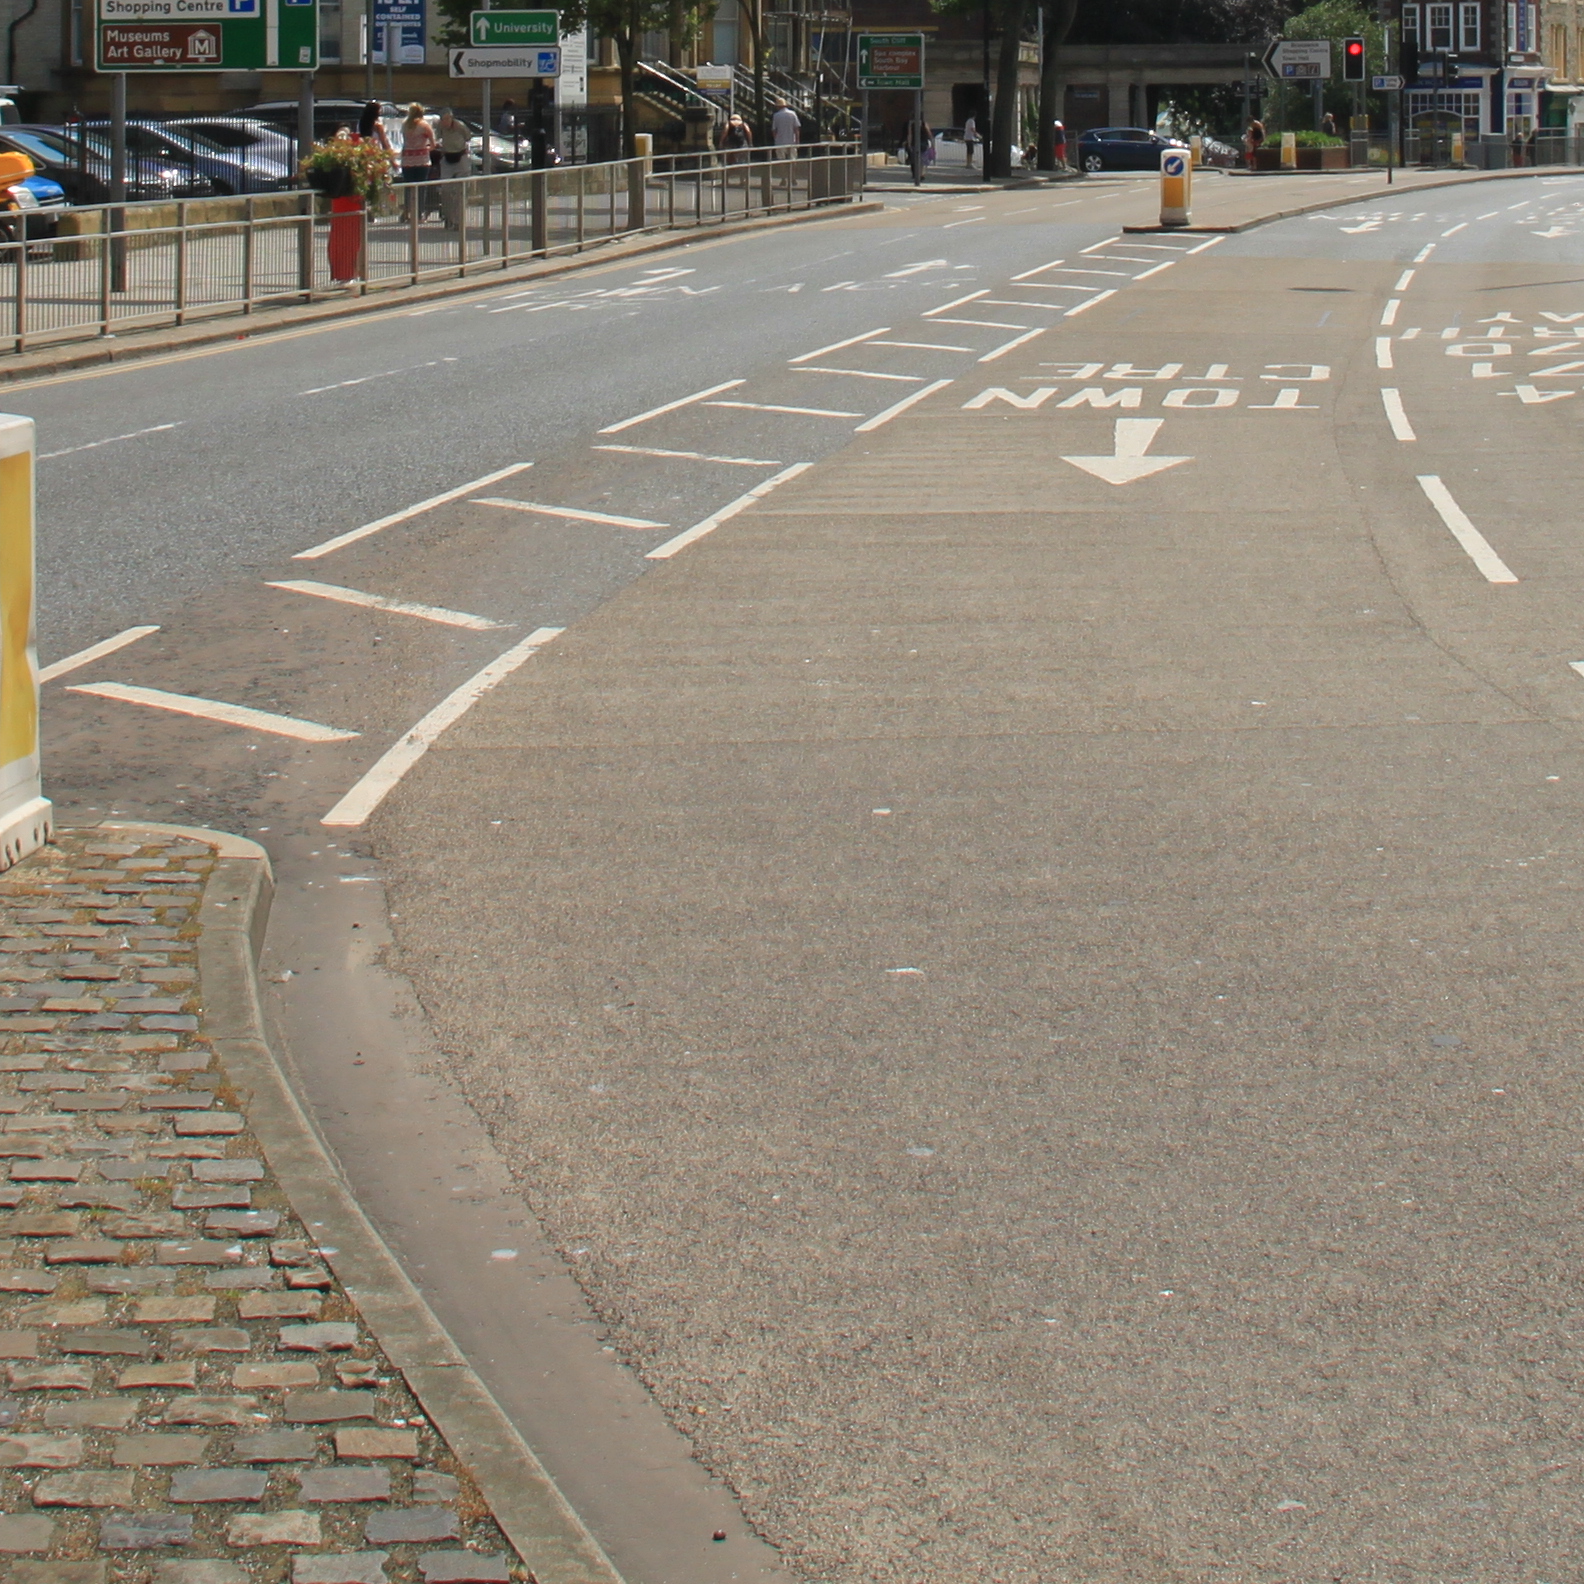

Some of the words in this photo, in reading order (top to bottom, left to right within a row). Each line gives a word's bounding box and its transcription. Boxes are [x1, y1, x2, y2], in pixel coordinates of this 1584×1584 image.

[106, 0, 171, 14] Shopping
[176, 0, 224, 12] Centre
[494, 22, 554, 35] University
[106, 30, 170, 42] Museums
[107, 46, 129, 58] Art
[133, 45, 183, 59] Gallery
[467, 58, 533, 68] Shopmobility
[1018, 362, 1331, 381] CTRE
[960, 387, 1320, 409] TOWN
